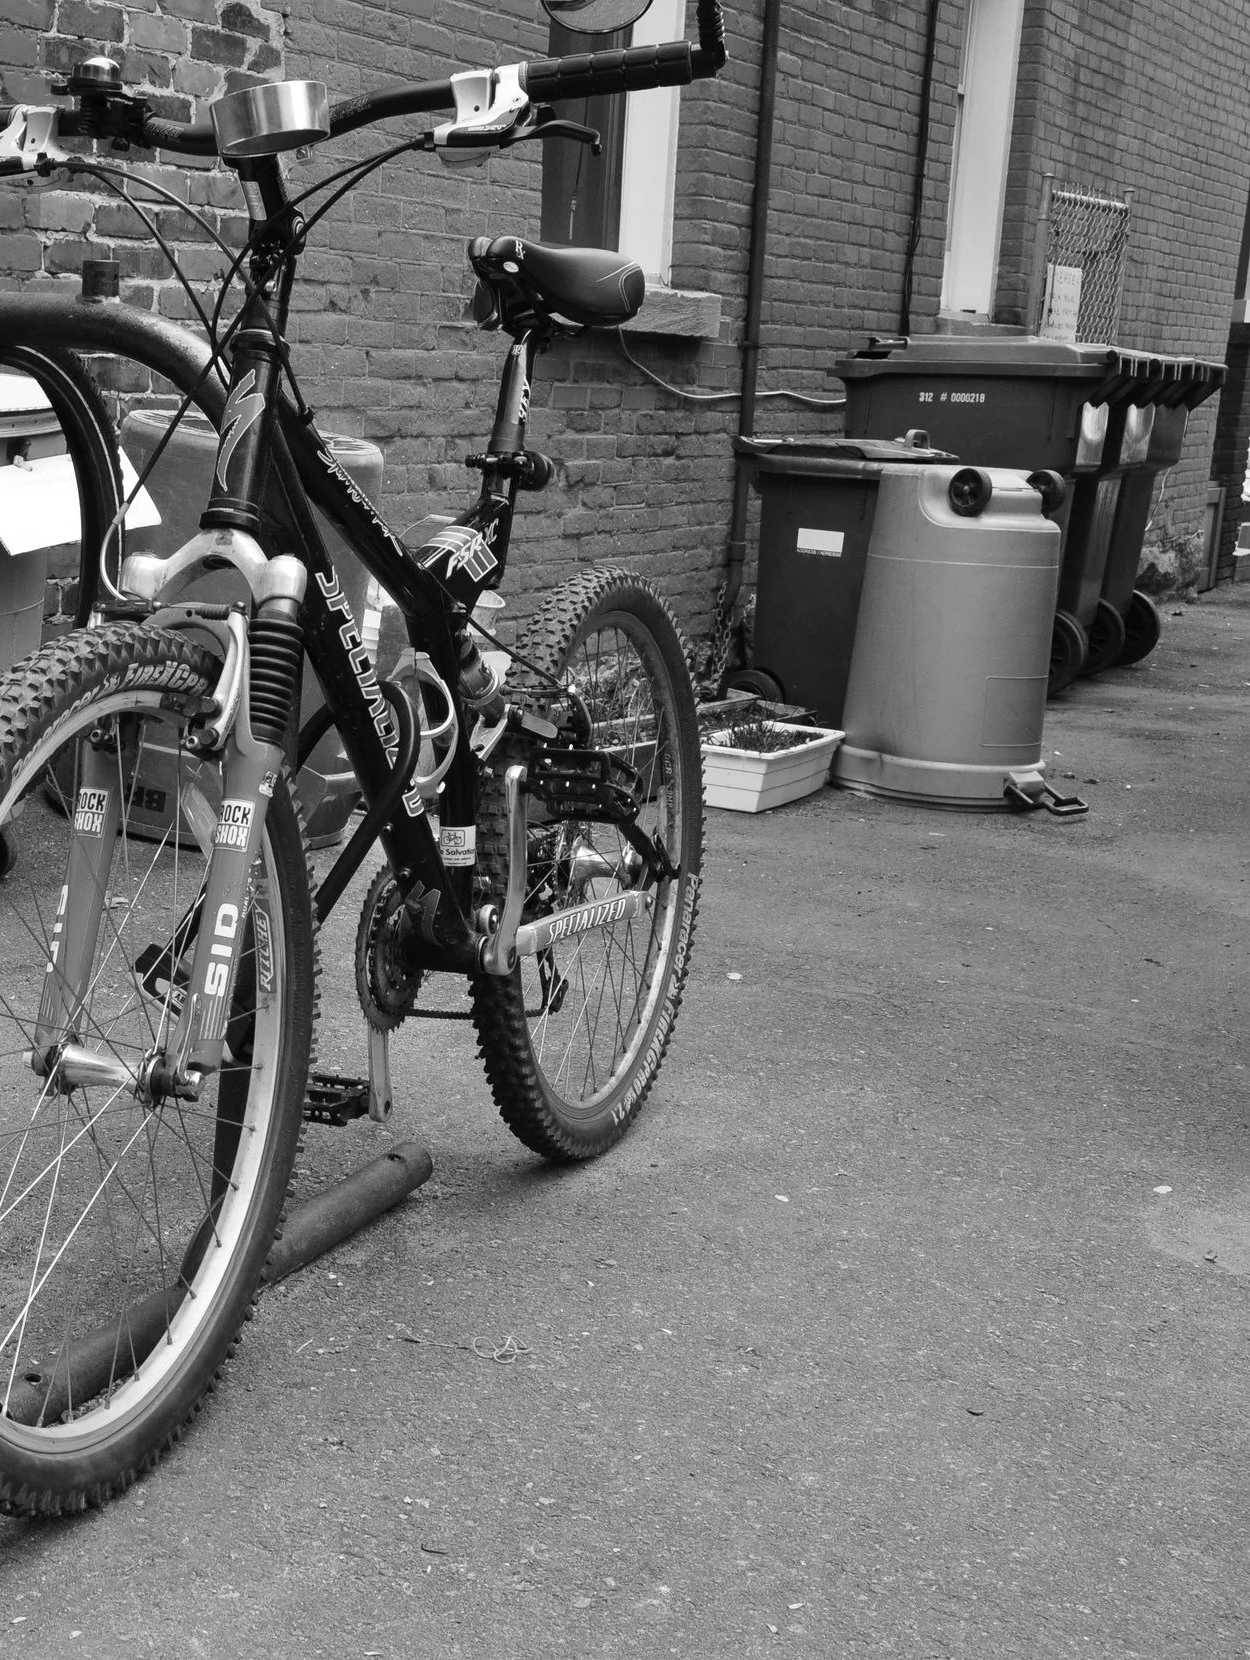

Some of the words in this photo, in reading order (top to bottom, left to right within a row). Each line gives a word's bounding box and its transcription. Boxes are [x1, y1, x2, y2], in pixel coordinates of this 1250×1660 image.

[918, 391, 933, 402] 312
[314, 565, 425, 818] SPECIALIZD
[77, 791, 106, 812] OCK
[214, 824, 249, 847] SHOX
[545, 898, 627, 946] SPECIALIZED
[204, 902, 240, 997] SID
